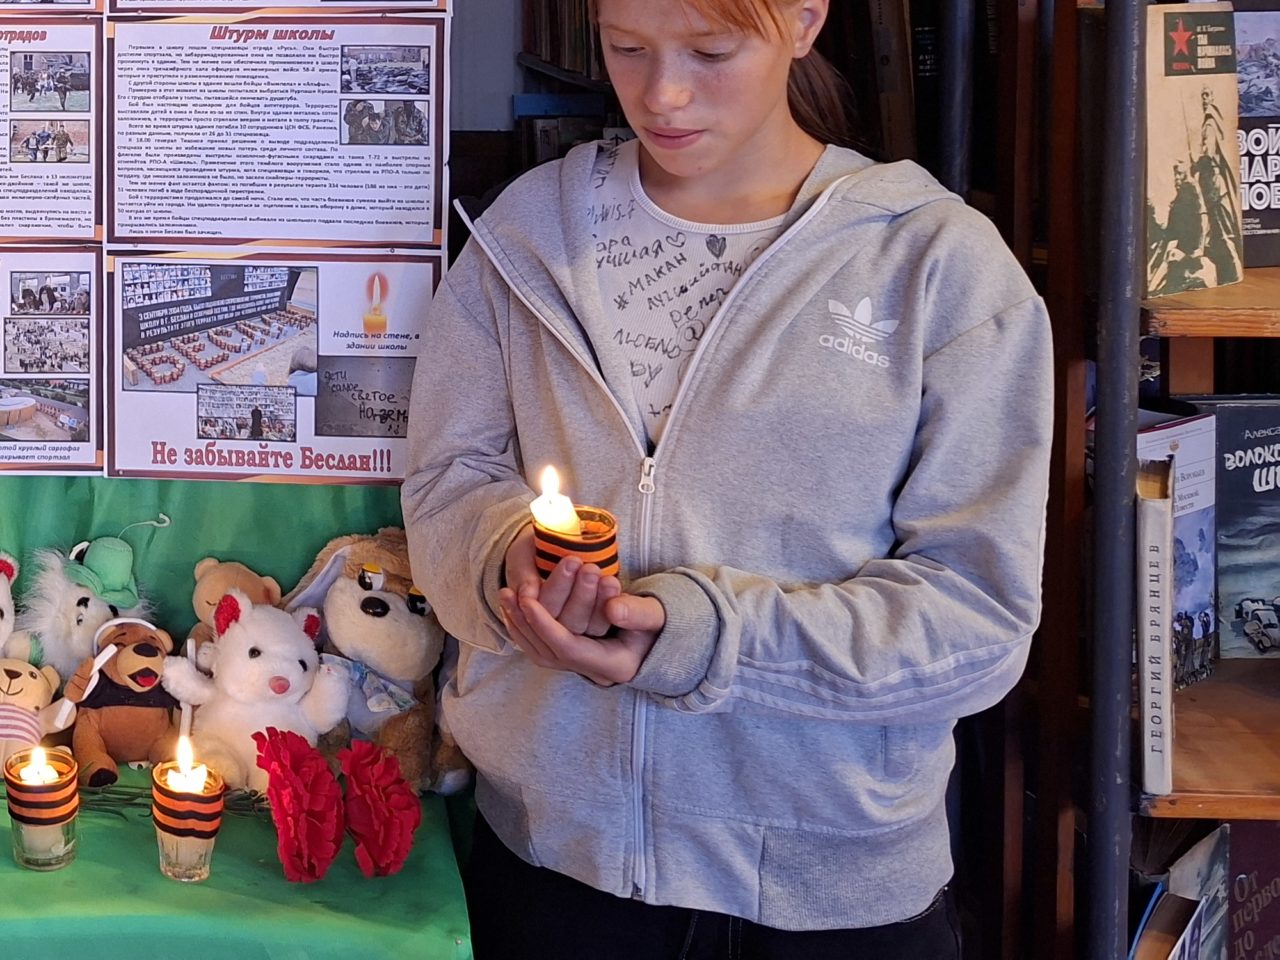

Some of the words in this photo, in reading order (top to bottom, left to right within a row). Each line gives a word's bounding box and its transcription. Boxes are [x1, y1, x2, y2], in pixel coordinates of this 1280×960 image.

[210, 26, 268, 43] Штурм
[273, 29, 334, 40] школы
[333, 330, 368, 340] Надпись
[371, 332, 381, 340] на
[384, 333, 412, 341] стене,
[346, 342, 376, 350] здании
[378, 343, 408, 351] школы
[819, 331, 891, 369] adidas
[151, 441, 176, 464] Не
[185, 440, 292, 468] забывайте
[300, 444, 394, 475] Беслан!!!
[1149, 544, 1162, 644] БРЯНЦЕВ
[1151, 655, 1163, 753] ГЕОРГИЙ
[1234, 871, 1258, 902] От
